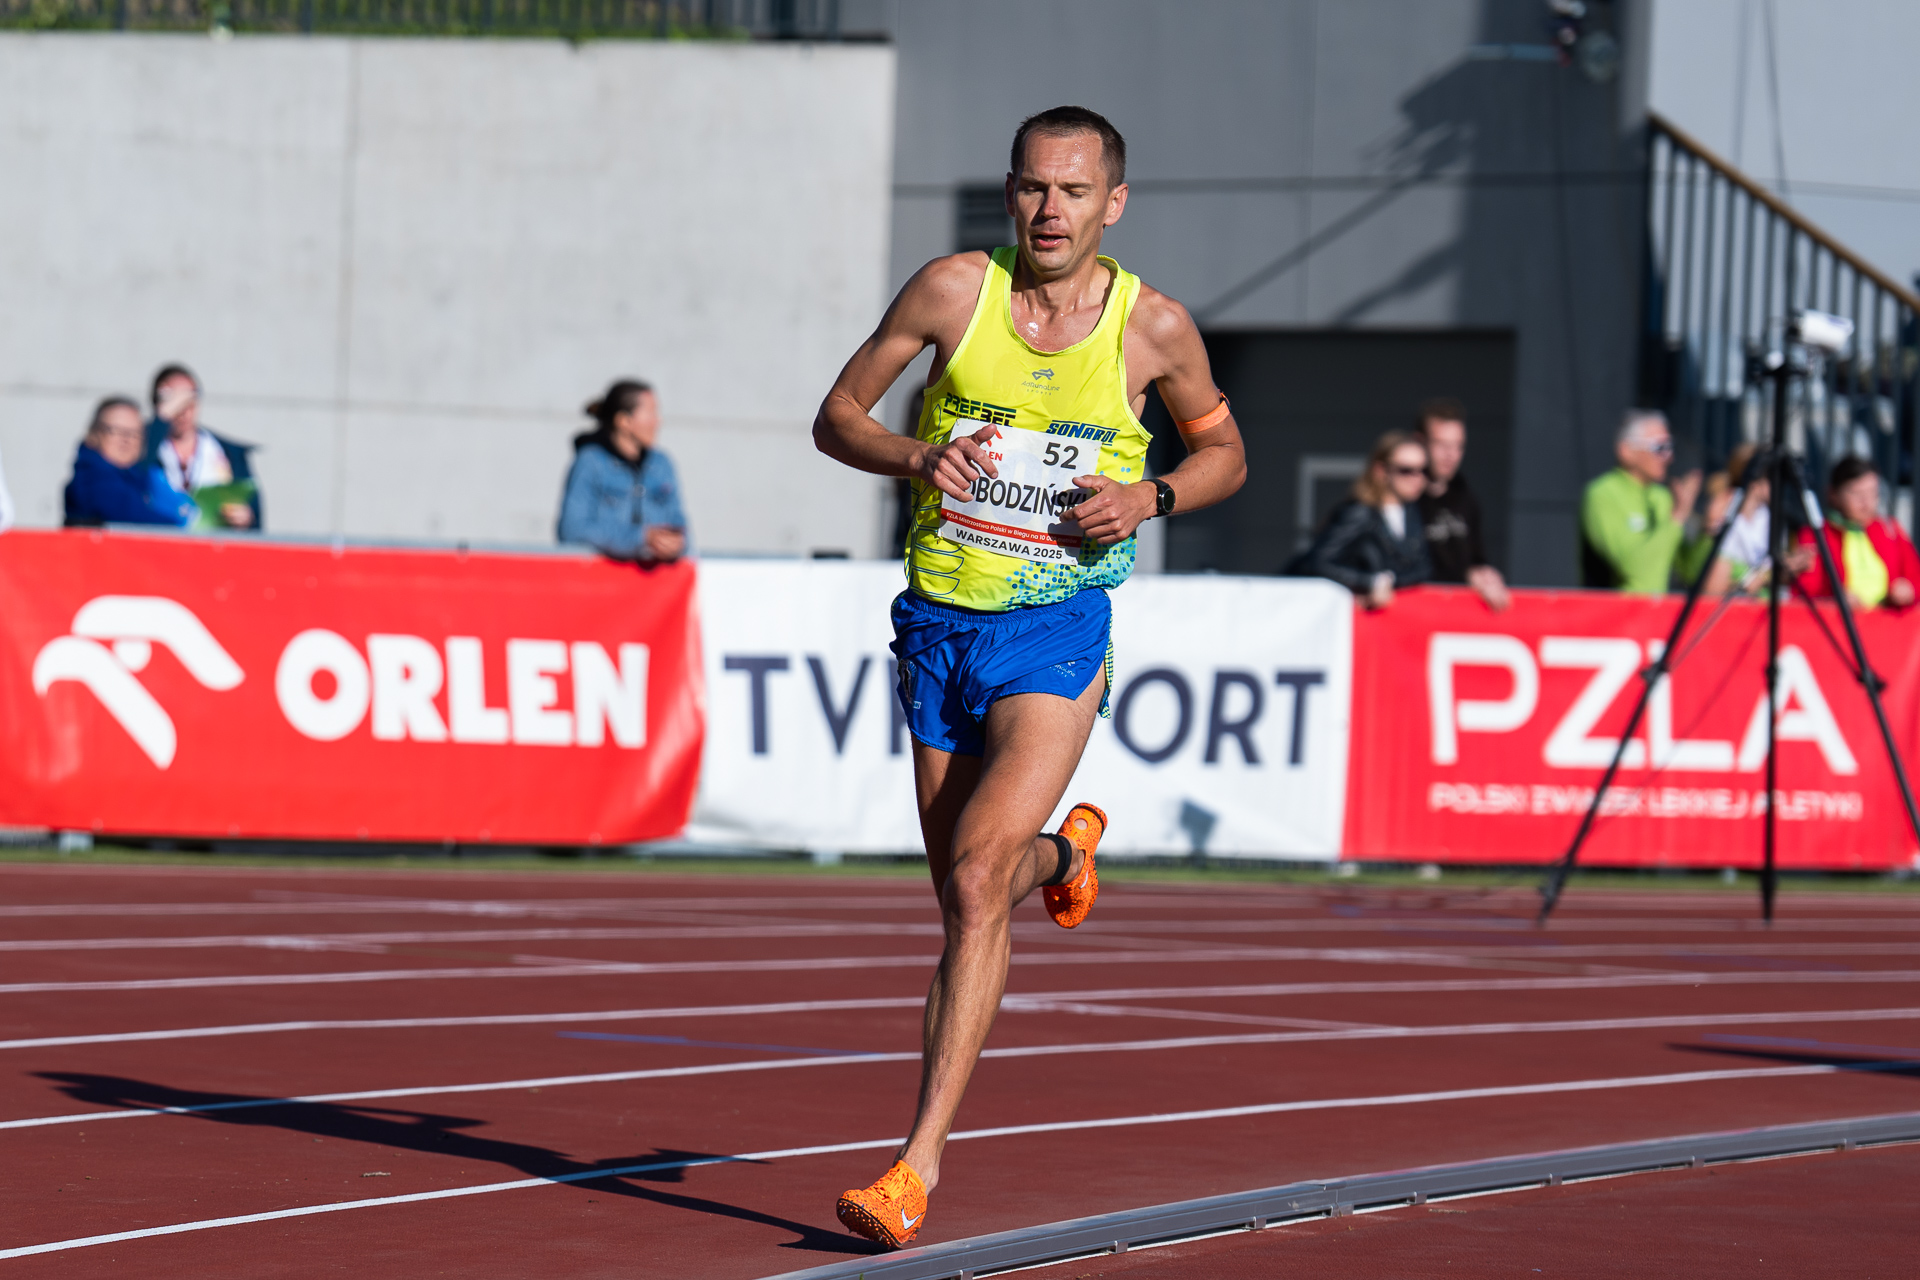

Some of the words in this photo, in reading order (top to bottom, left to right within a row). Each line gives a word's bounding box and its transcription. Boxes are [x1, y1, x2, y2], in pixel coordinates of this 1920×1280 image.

[1046, 421, 1118, 444] SONAROL
[1043, 442, 1079, 470] 52
[971, 475, 1088, 517] BODZIŃSK
[946, 512, 959, 520] PZLA
[959, 516, 989, 530] Mistrzostwa
[990, 525, 1007, 533] Polski
[1013, 528, 1030, 538] Biegu
[956, 528, 1030, 555] WARSZAWA
[1033, 547, 1063, 559] 2025
[275, 628, 650, 748] ORLEN
[1428, 631, 1858, 775] PZLA
[1114, 665, 1327, 767] ORT
